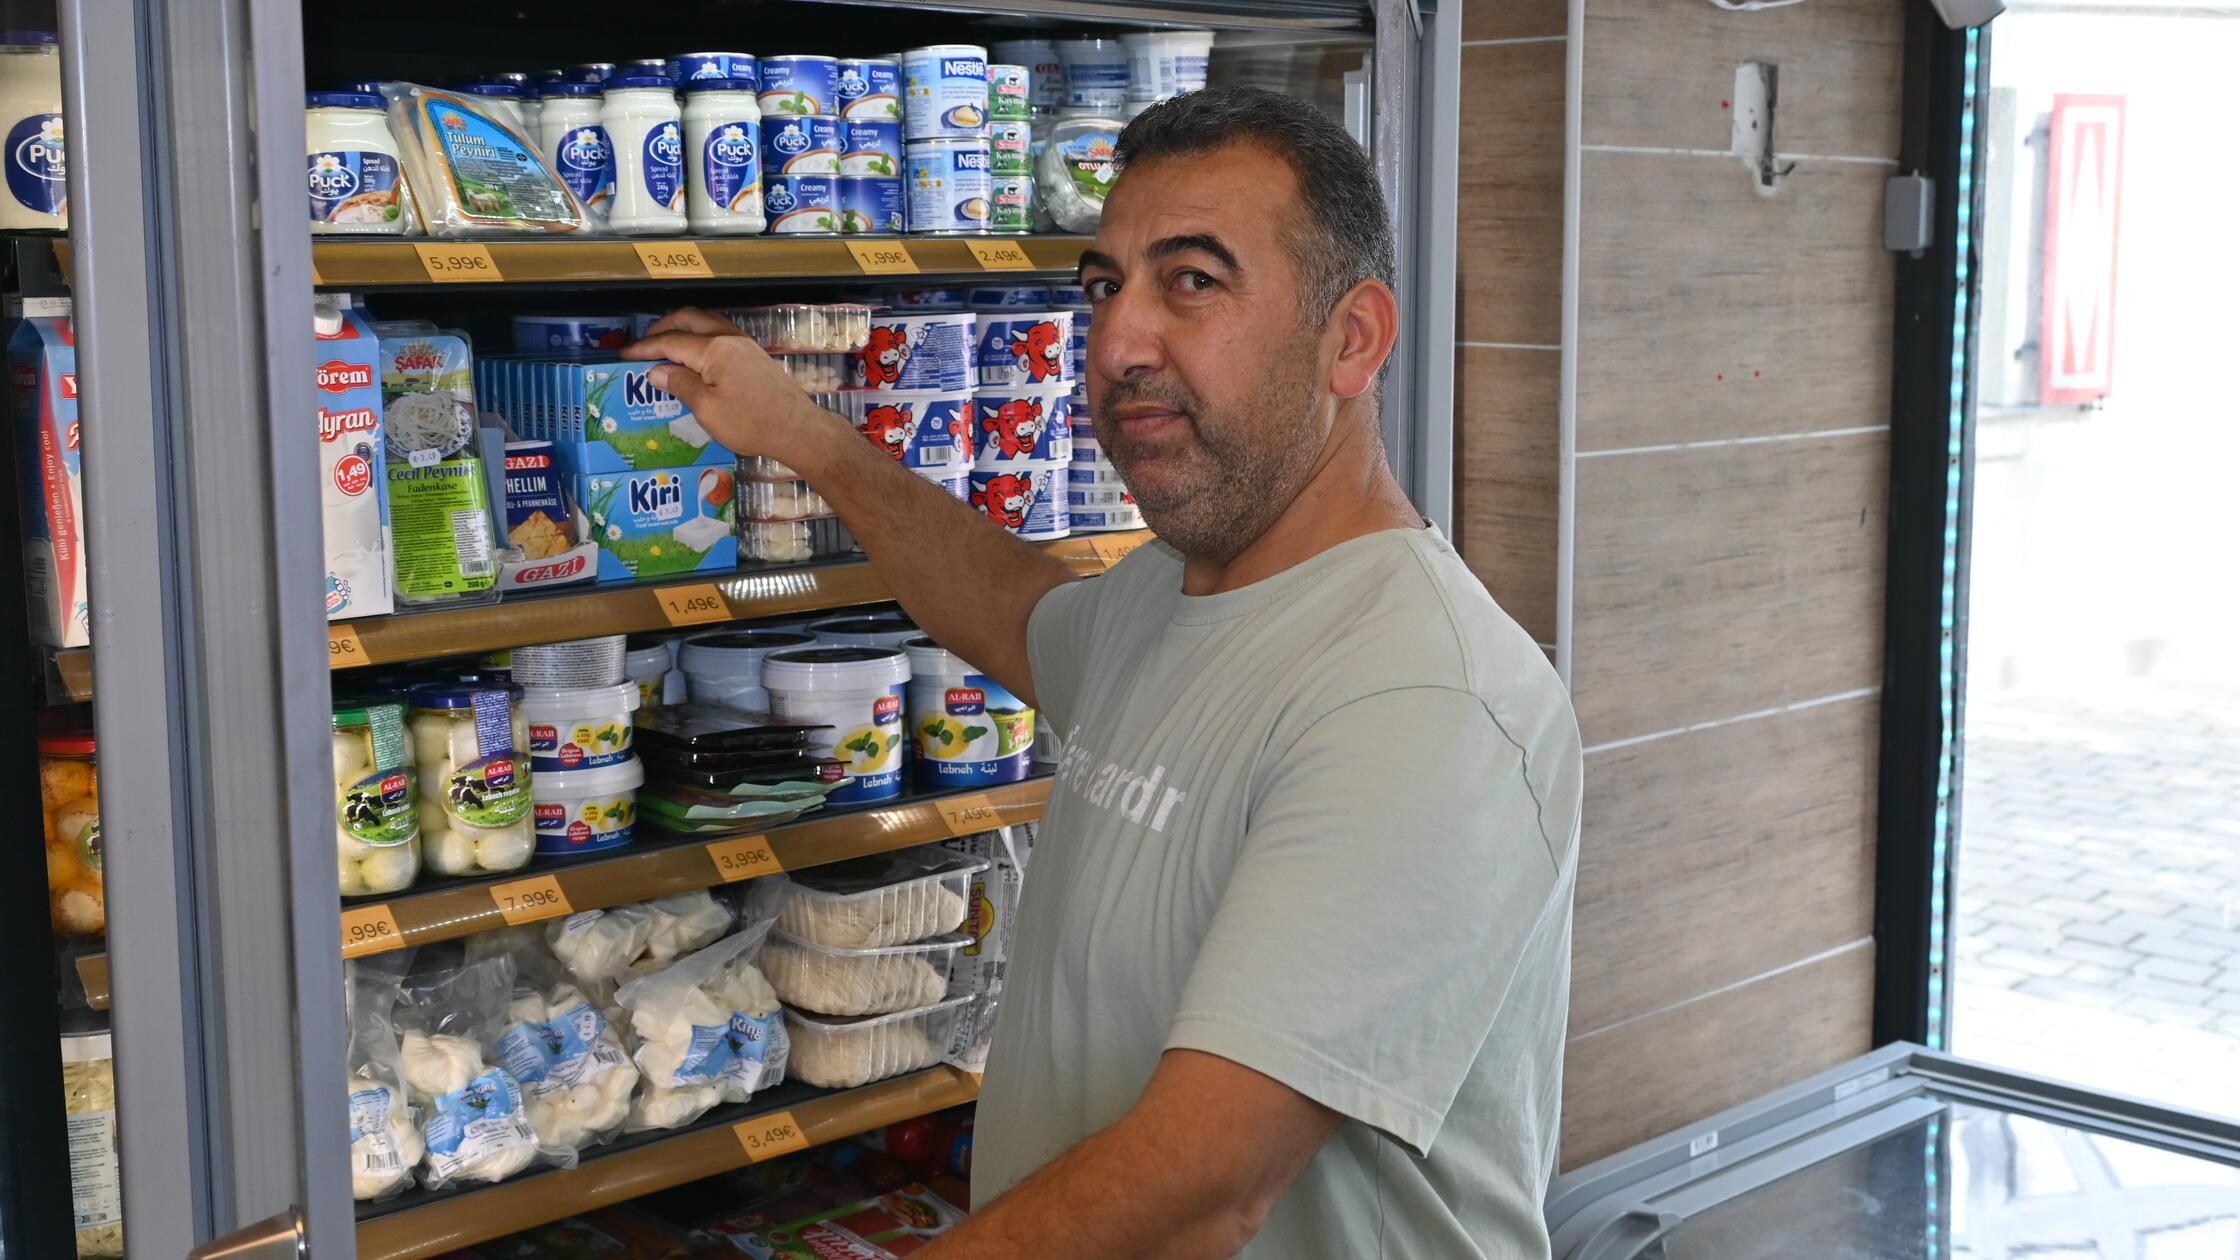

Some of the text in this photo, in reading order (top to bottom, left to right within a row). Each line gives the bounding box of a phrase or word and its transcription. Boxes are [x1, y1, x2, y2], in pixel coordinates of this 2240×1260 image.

[764, 66, 790, 77] Creamy
[872, 70, 894, 80] Creamy
[839, 82, 864, 92] Puck
[447, 132, 486, 147] Tulum
[851, 128, 878, 138] Creamy
[451, 143, 497, 158] Peyniri
[717, 142, 752, 157] Puck
[779, 137, 807, 148] Puck
[29, 144, 65, 163] Pu
[570, 147, 606, 161] Puck
[309, 173, 352, 189] Puck
[801, 184, 827, 193] Creamy
[767, 196, 793, 207] Puck
[429, 255, 488, 272] 5,99€
[648, 253, 702, 268] 3,49€
[860, 251, 906, 266] 1,99€
[978, 250, 1024, 263] 2,49€
[317, 369, 369, 386] örem
[41, 430, 51, 451] cool
[337, 462, 366, 482] 1,49
[387, 465, 421, 482] Cecil
[506, 476, 548, 493] HELLIM
[629, 476, 681, 513] Kiri
[668, 596, 720, 615] 1,49€
[720, 849, 770, 870] 3,99€
[503, 889, 559, 912] 7,99€
[348, 920, 392, 945] ,99€
[731, 1016, 765, 1042] King
[746, 1124, 797, 1149] 3,49€
